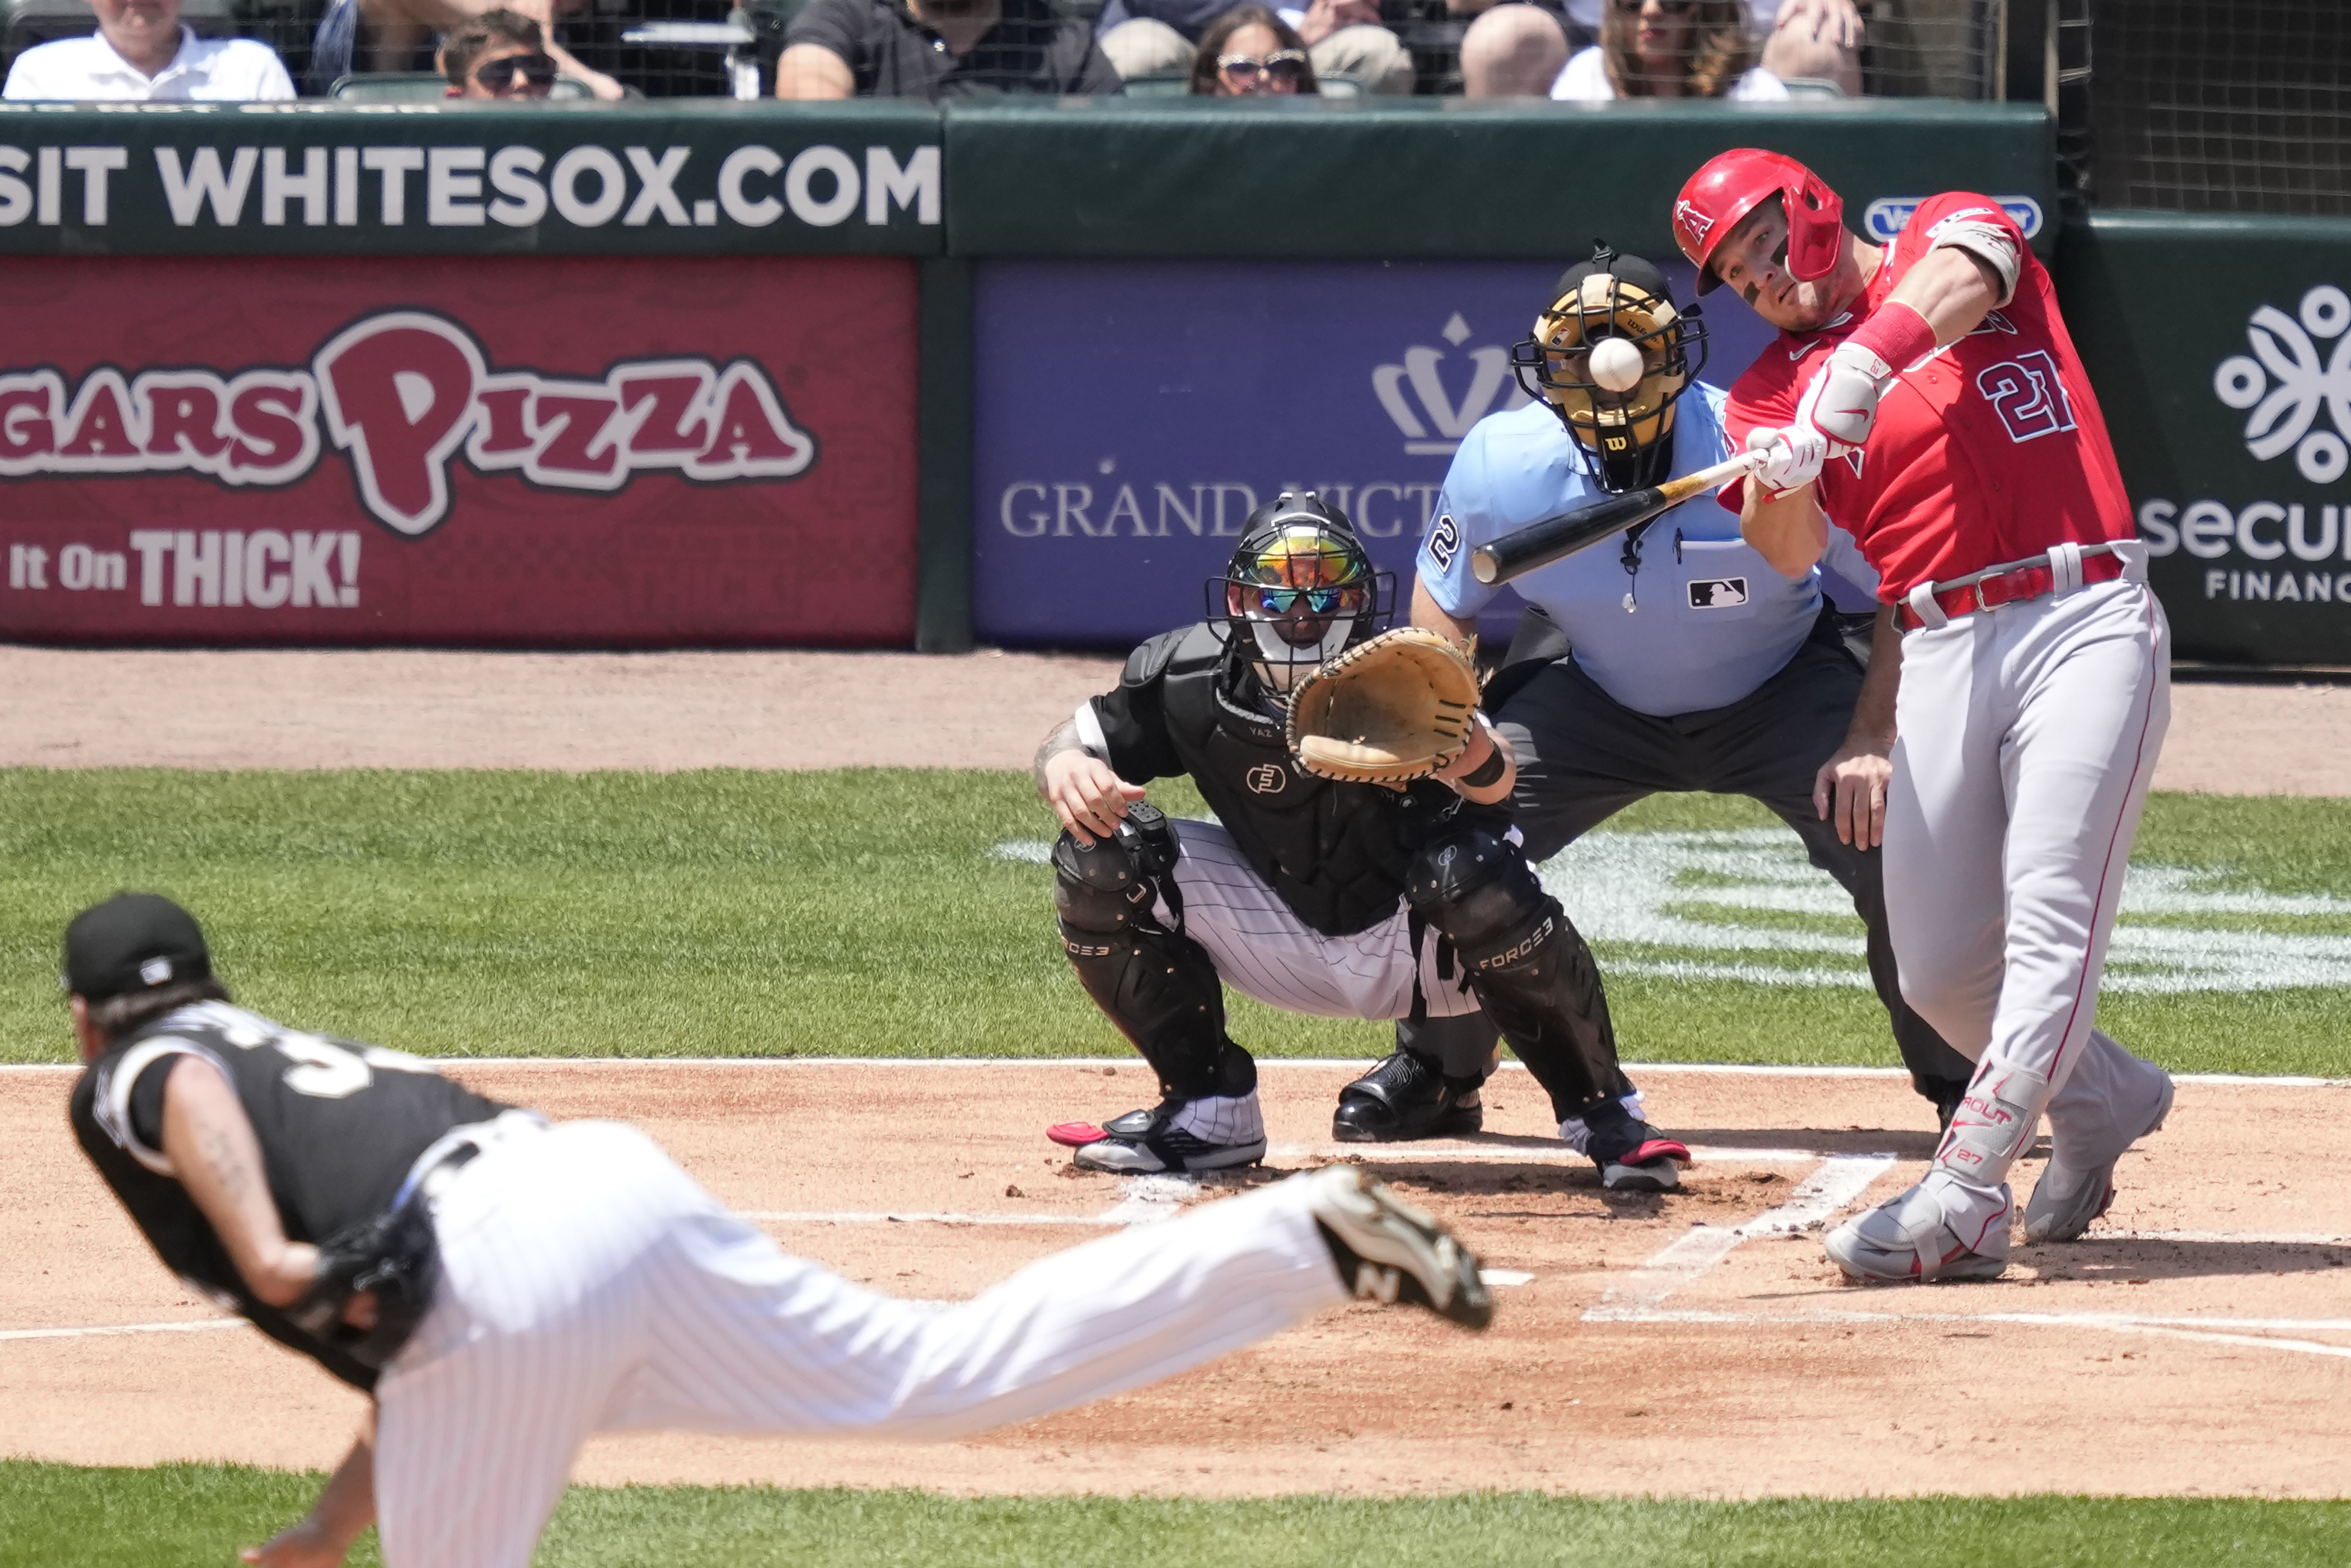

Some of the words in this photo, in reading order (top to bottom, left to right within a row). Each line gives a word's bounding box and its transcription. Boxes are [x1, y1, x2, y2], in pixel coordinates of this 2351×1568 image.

[154, 144, 942, 228] WHITESOX.COM
[1000, 480, 1258, 538] GRAND
[10, 543, 50, 590] It
[58, 543, 127, 591] On
[130, 529, 361, 608] THICK!
[1428, 514, 1461, 574] 2
[1957, 1148, 1984, 1165] 27
